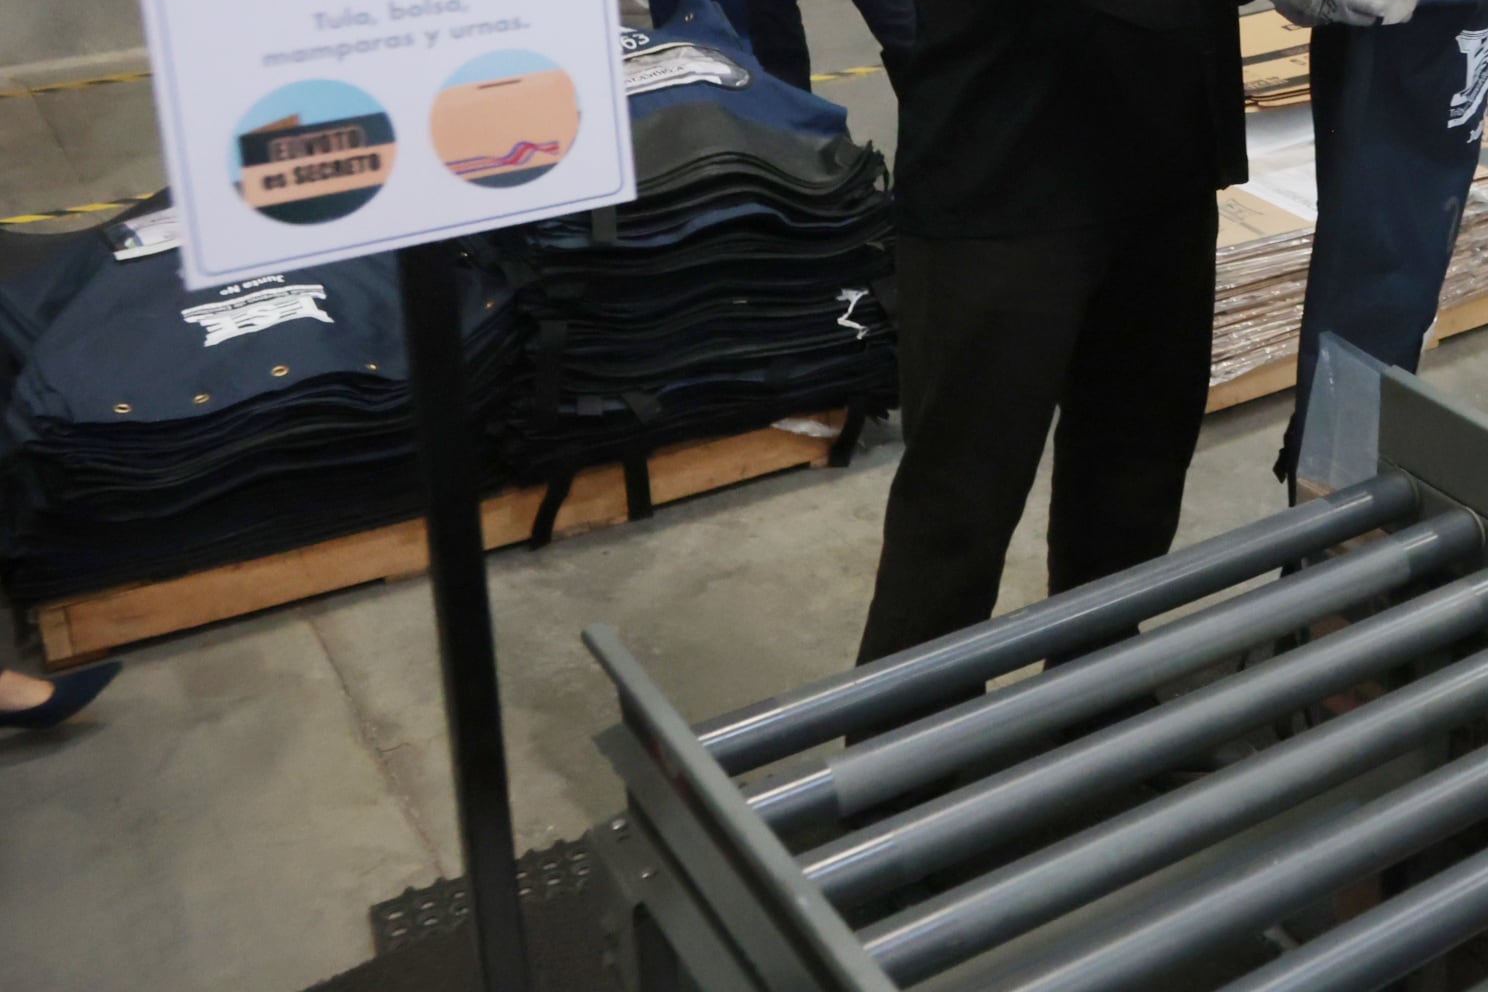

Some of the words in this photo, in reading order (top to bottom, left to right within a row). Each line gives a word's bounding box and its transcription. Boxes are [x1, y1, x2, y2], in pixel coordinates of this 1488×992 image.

[312, 7, 378, 31] Tula,
[261, 33, 416, 67] mamparas
[424, 30, 440, 49] y
[294, 153, 381, 185] SECRETO
